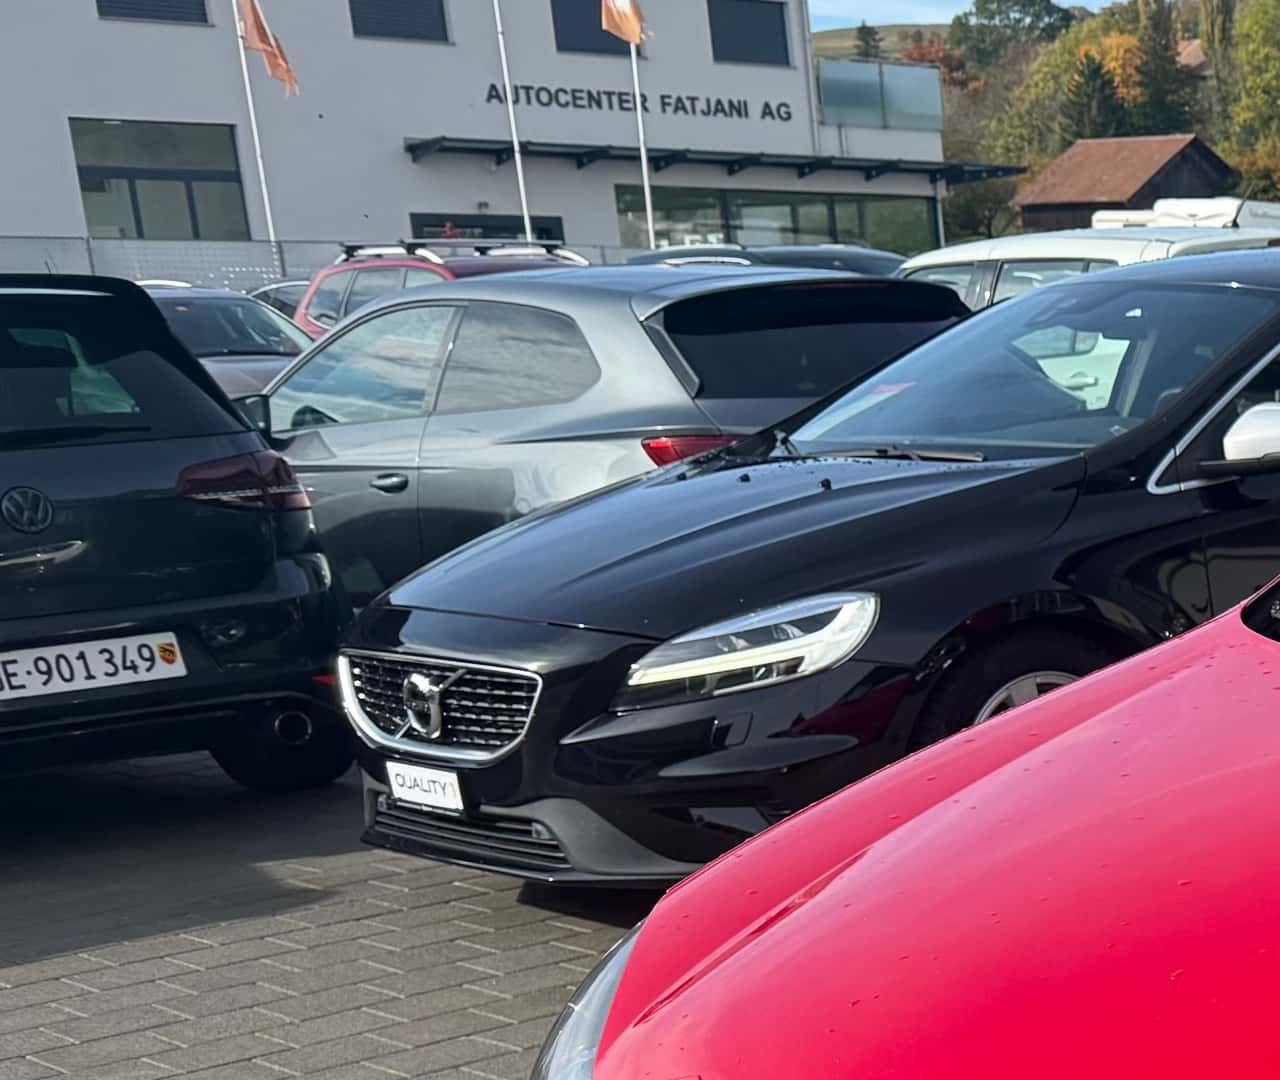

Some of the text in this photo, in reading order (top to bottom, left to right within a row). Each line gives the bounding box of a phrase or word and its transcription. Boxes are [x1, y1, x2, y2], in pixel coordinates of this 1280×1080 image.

[486, 83, 793, 122] AUTOCENTER FATJANI AG
